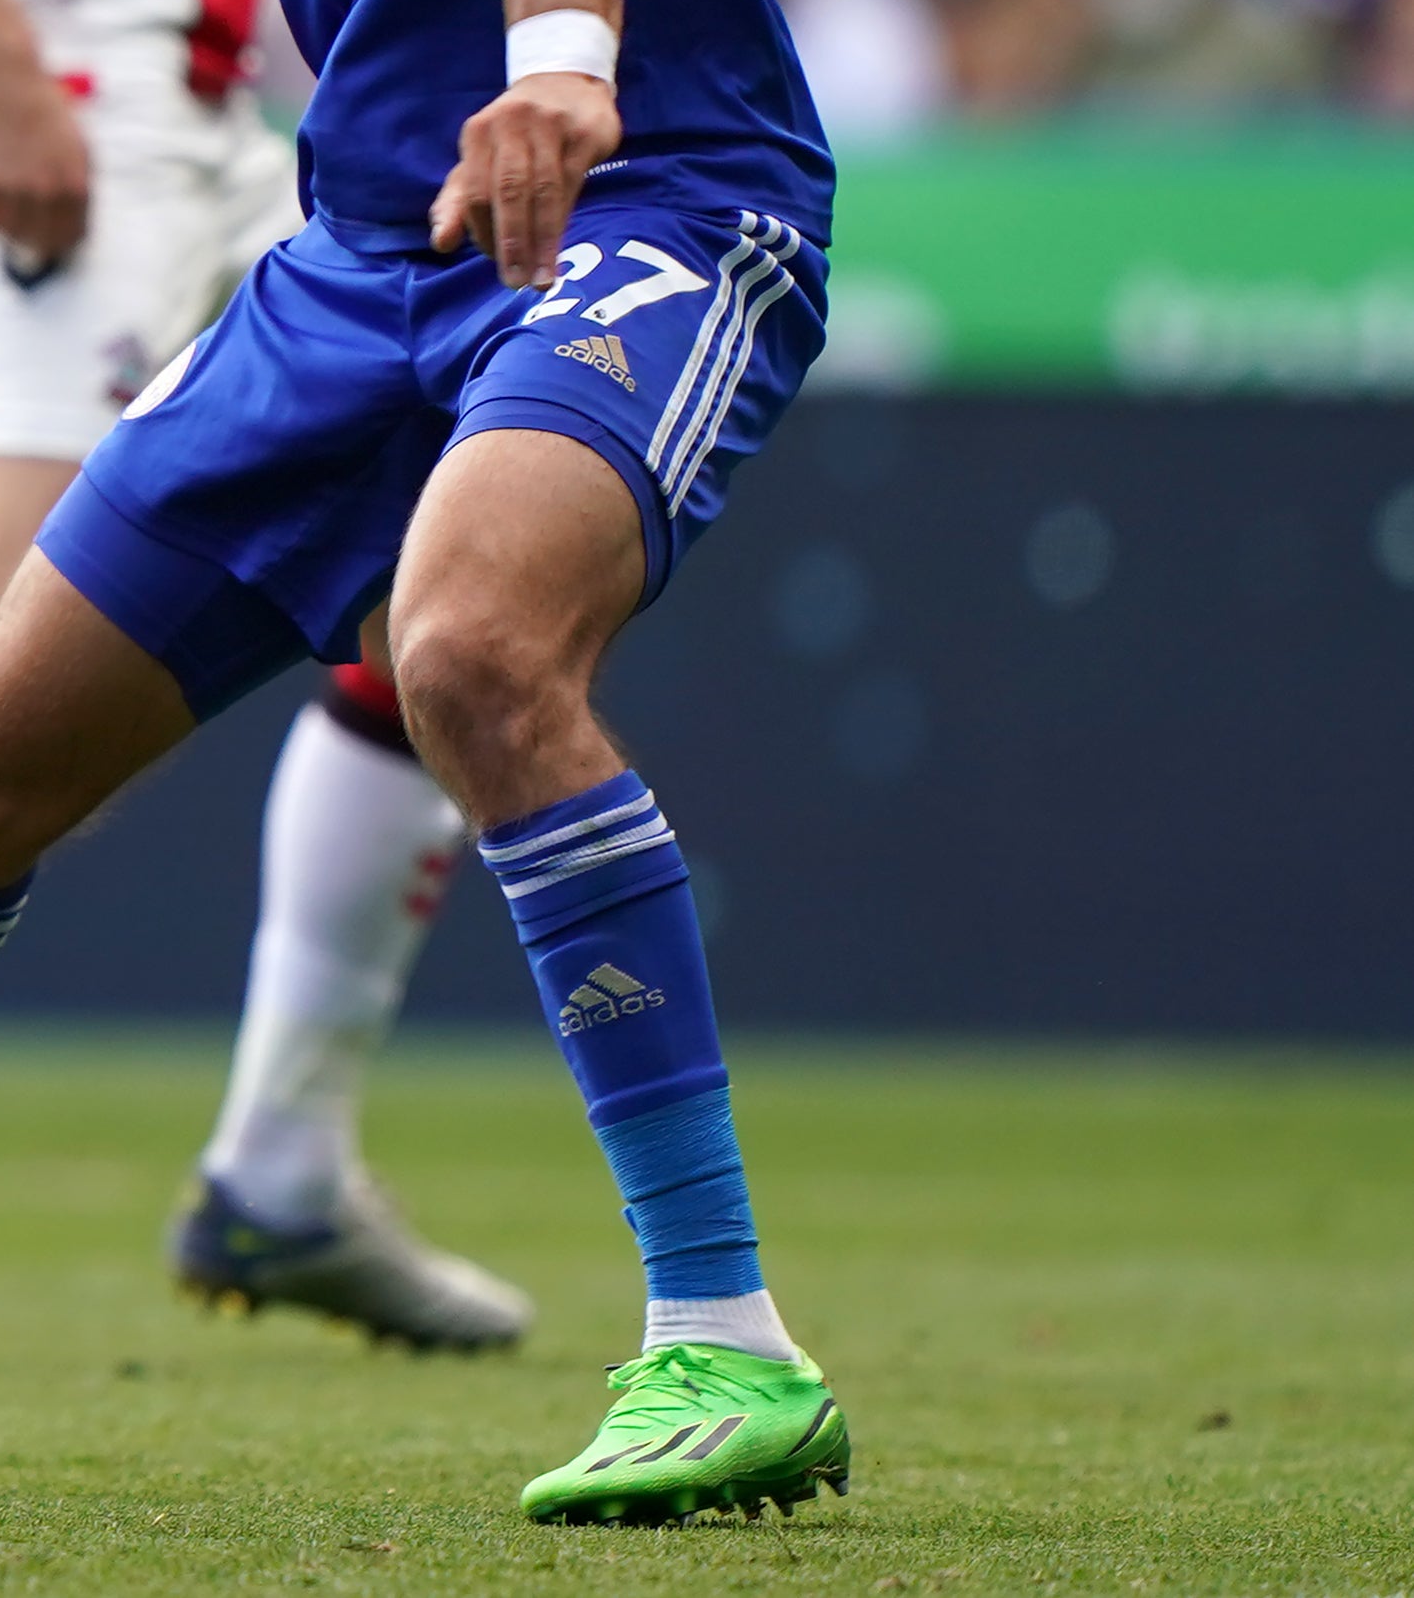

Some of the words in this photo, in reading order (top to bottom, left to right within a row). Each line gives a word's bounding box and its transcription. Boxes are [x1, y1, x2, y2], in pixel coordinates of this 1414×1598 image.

[520, 240, 711, 327] 27
[554, 344, 636, 393] adidas
[558, 988, 666, 1037] adidas
